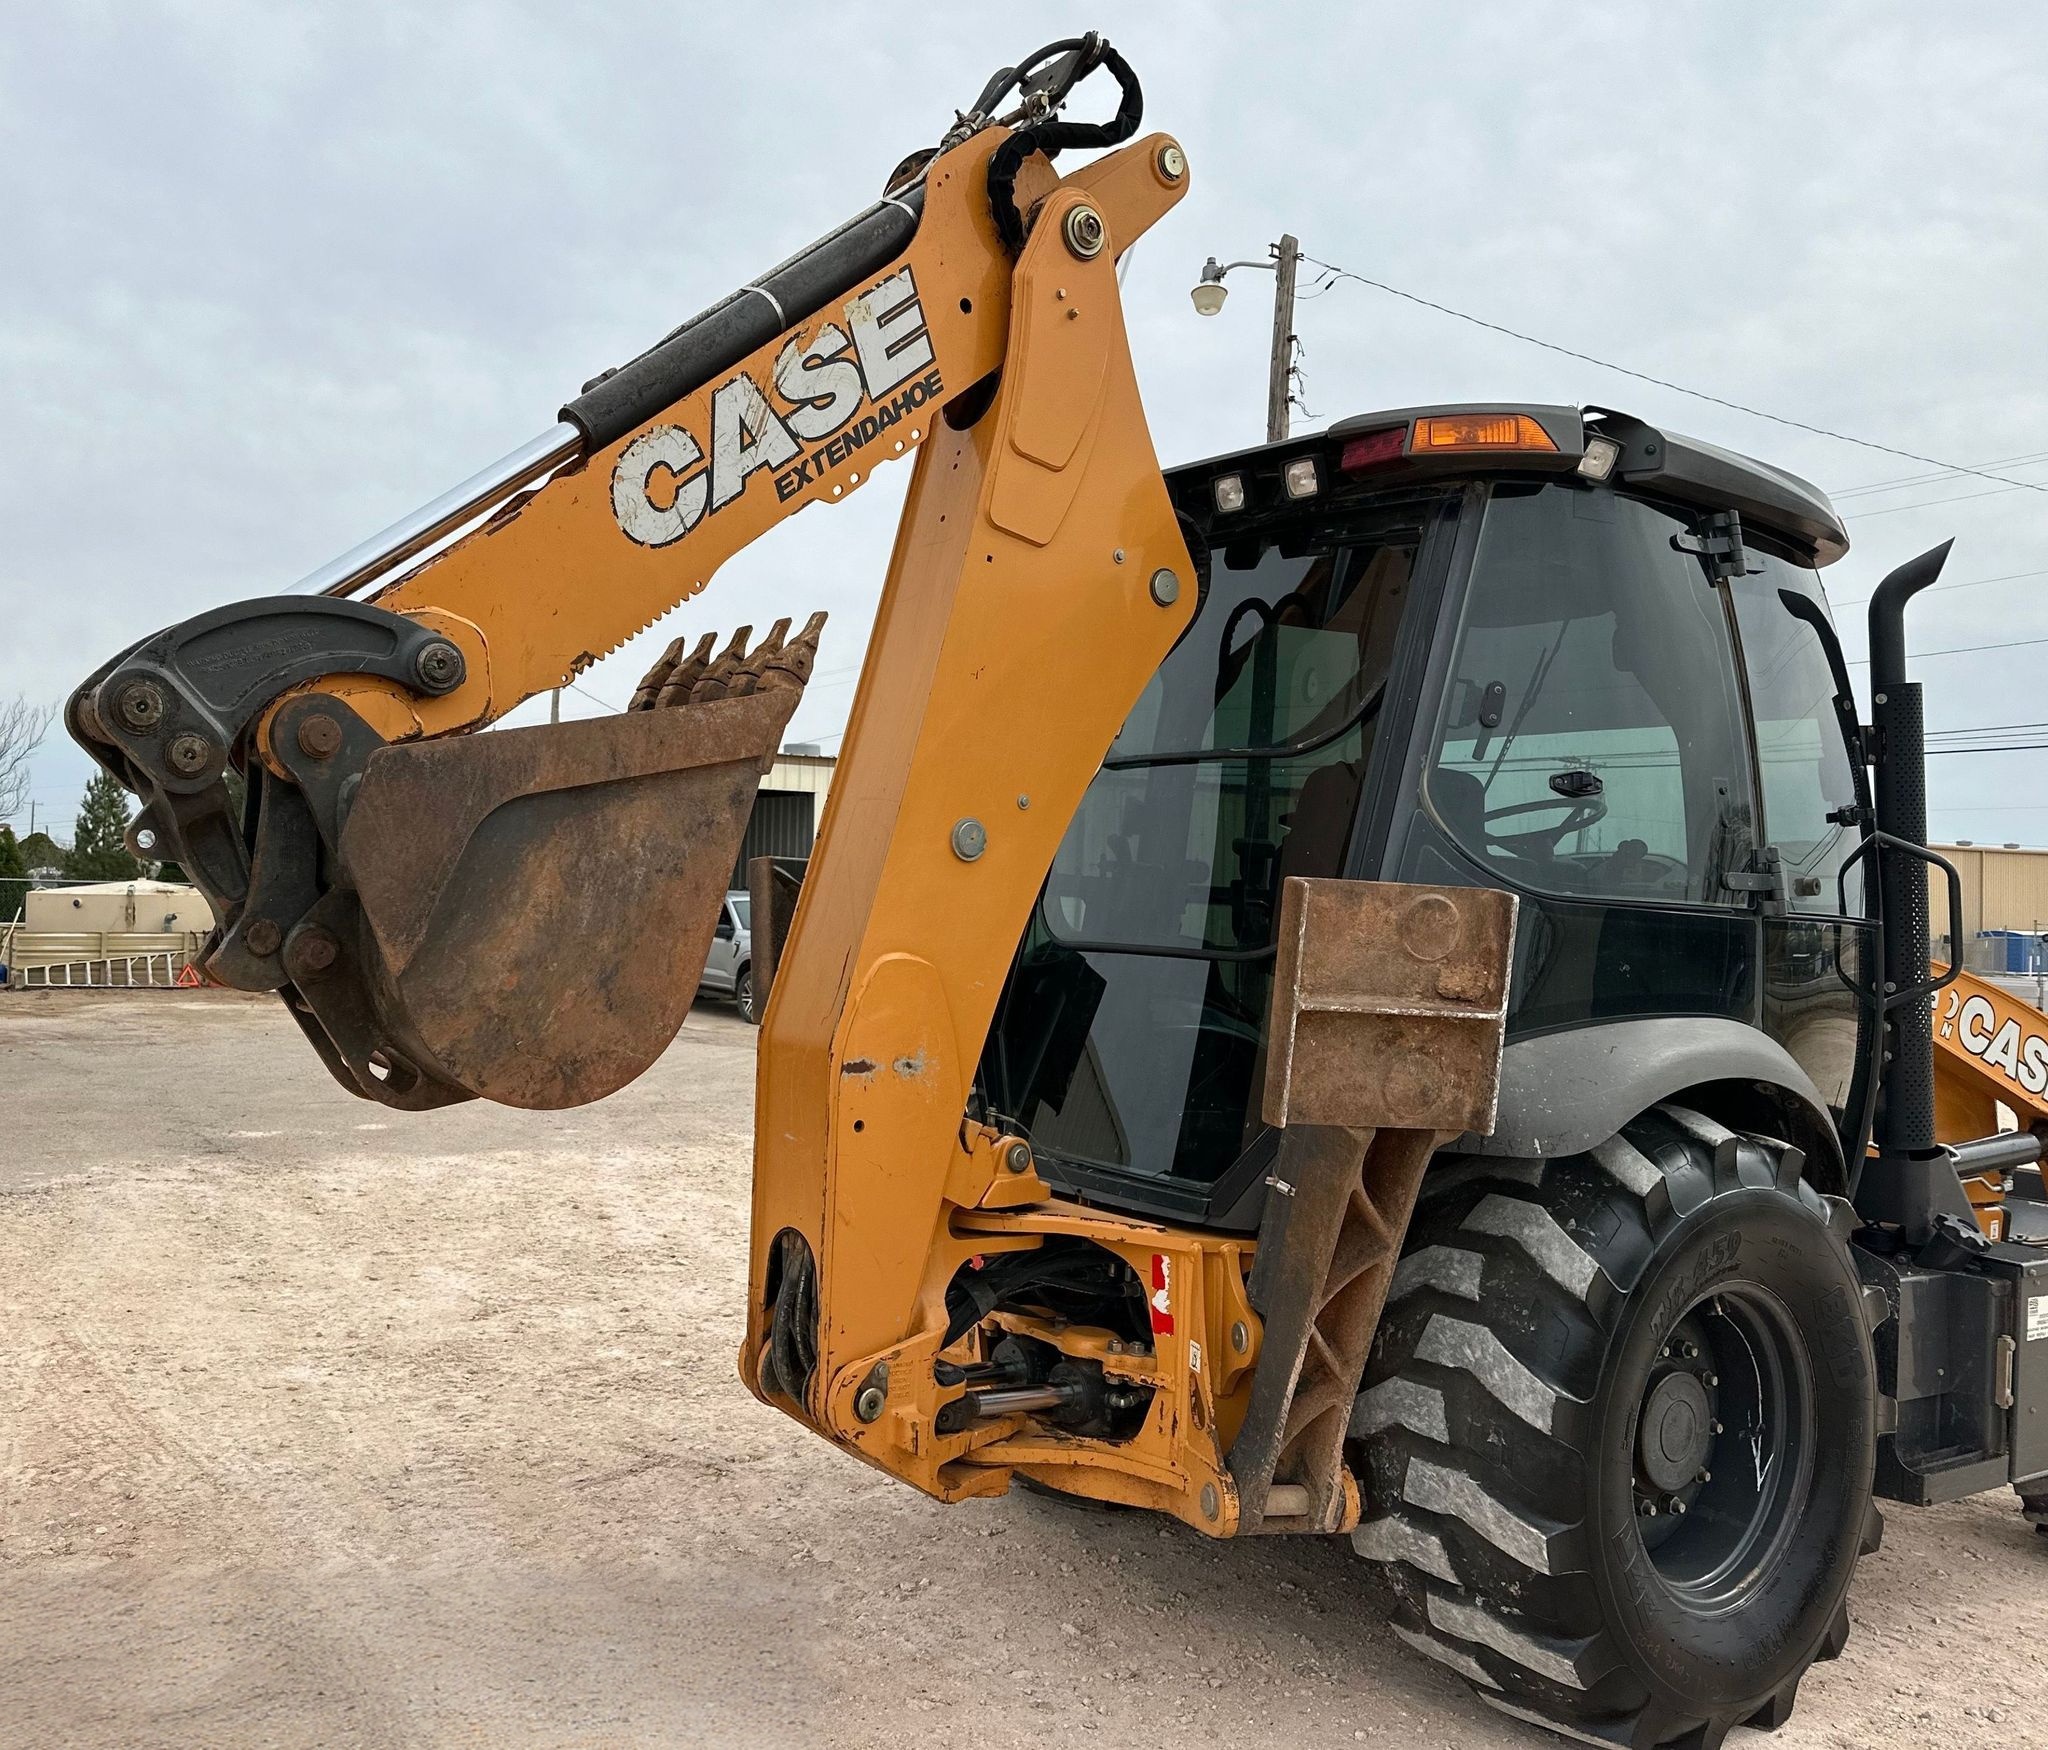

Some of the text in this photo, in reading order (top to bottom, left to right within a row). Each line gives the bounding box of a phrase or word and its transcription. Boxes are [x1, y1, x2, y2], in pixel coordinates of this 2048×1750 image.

[610, 264, 937, 549] CASE
[775, 369, 944, 503] EXTENDAHOE
[1958, 995, 2048, 1102] CAS
